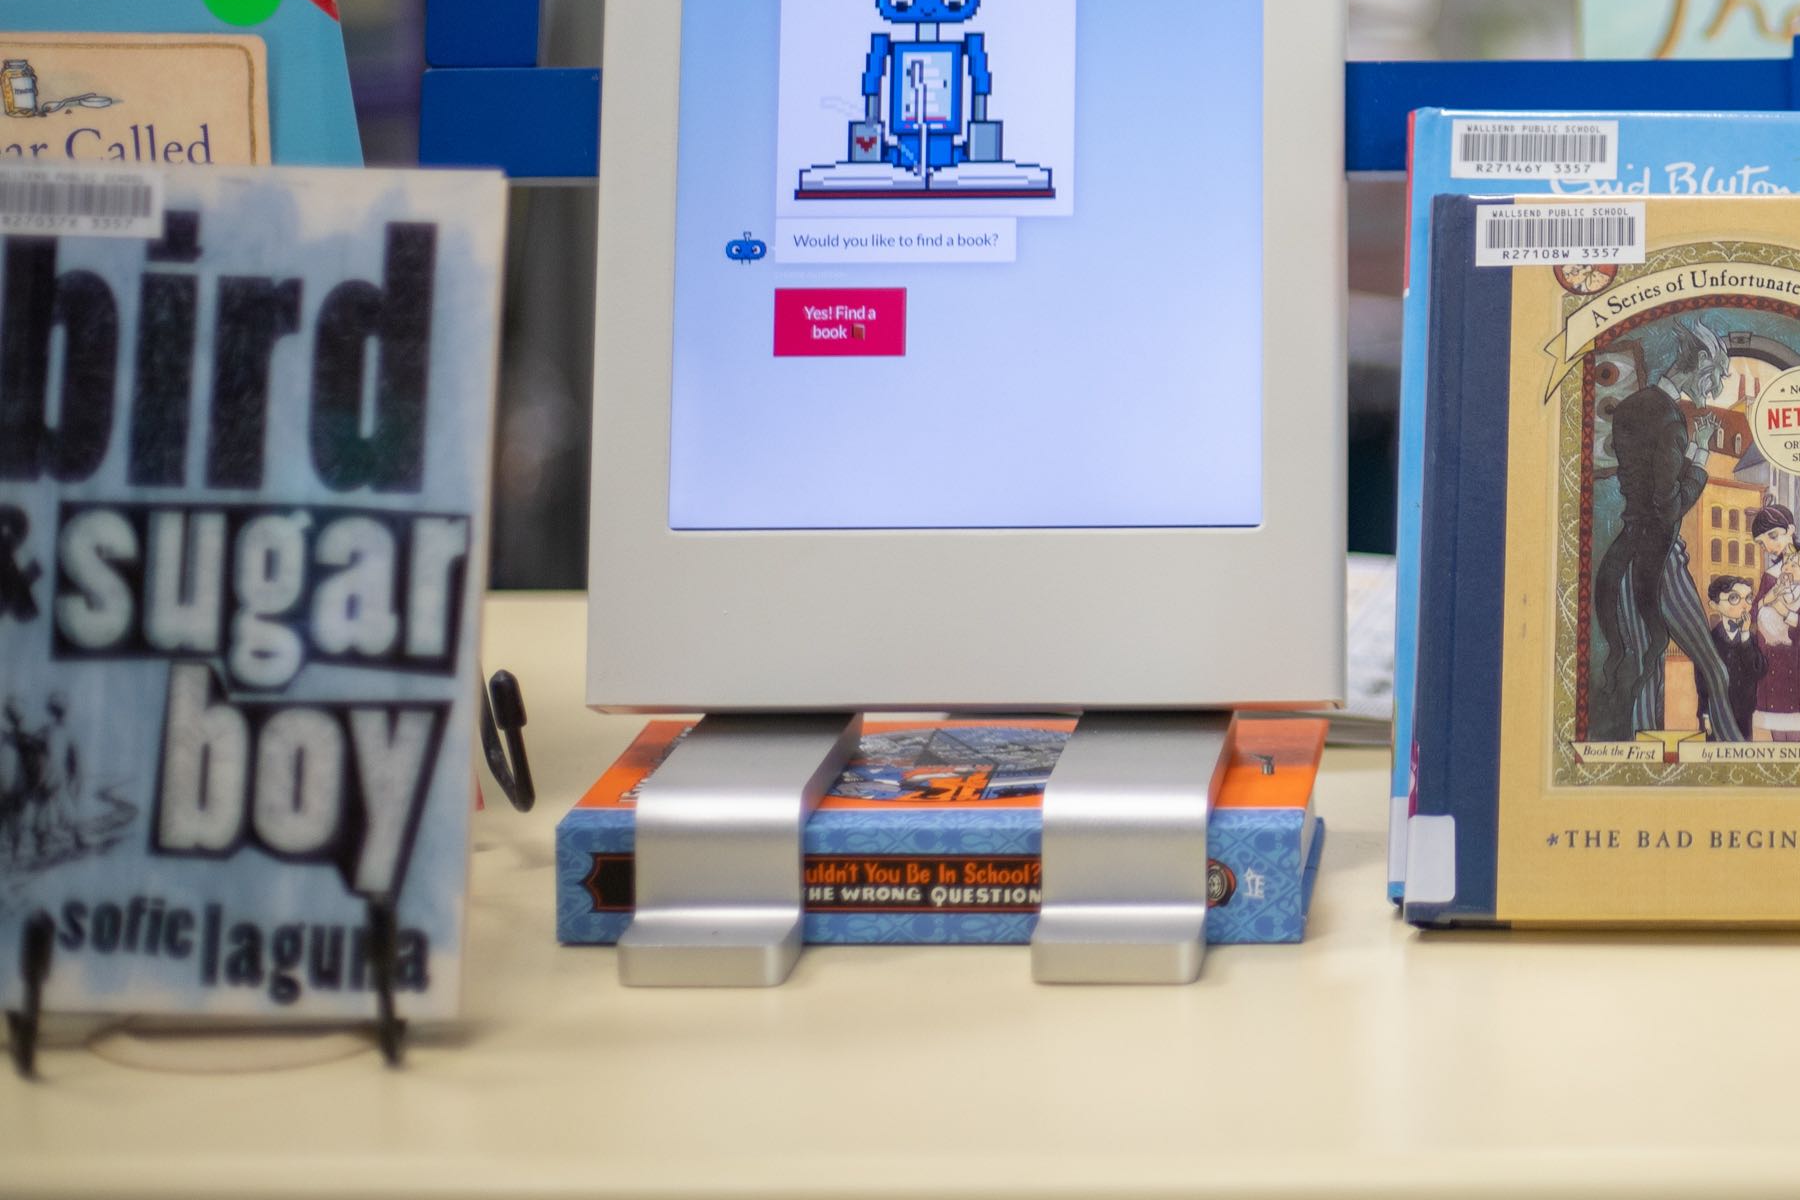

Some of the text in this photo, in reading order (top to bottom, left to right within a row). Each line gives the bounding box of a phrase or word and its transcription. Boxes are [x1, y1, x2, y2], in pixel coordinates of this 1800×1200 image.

[1467, 124, 1602, 134] WALLSEND PUBLIC SCHOOL
[65, 124, 214, 165] Called
[1476, 164, 1592, 174] R27146Y 3357
[1492, 208, 1629, 218] WALLSEND PUBLIC SCHOOL
[793, 233, 999, 251] Would you like to find a book?
[1502, 248, 1620, 260] R27108W 3357
[1591, 309, 1607, 328] A
[1607, 282, 1661, 315] Series
[1666, 273, 1685, 293] of
[804, 306, 876, 320] Yes! Find a
[812, 325, 848, 340] book
[0, 211, 438, 495] bird
[57, 508, 470, 692] sugar
[1583, 744, 1608, 757] Book
[1610, 746, 1625, 757] the
[1626, 746, 1656, 760] First
[1701, 748, 1714, 763] by
[1716, 748, 1776, 759] LEMONY
[157, 663, 437, 896] boy
[1565, 830, 1621, 848] THE
[1637, 830, 1694, 848] BAD
[863, 862, 1041, 885] You Be In School?
[841, 887, 921, 902] WRONG
